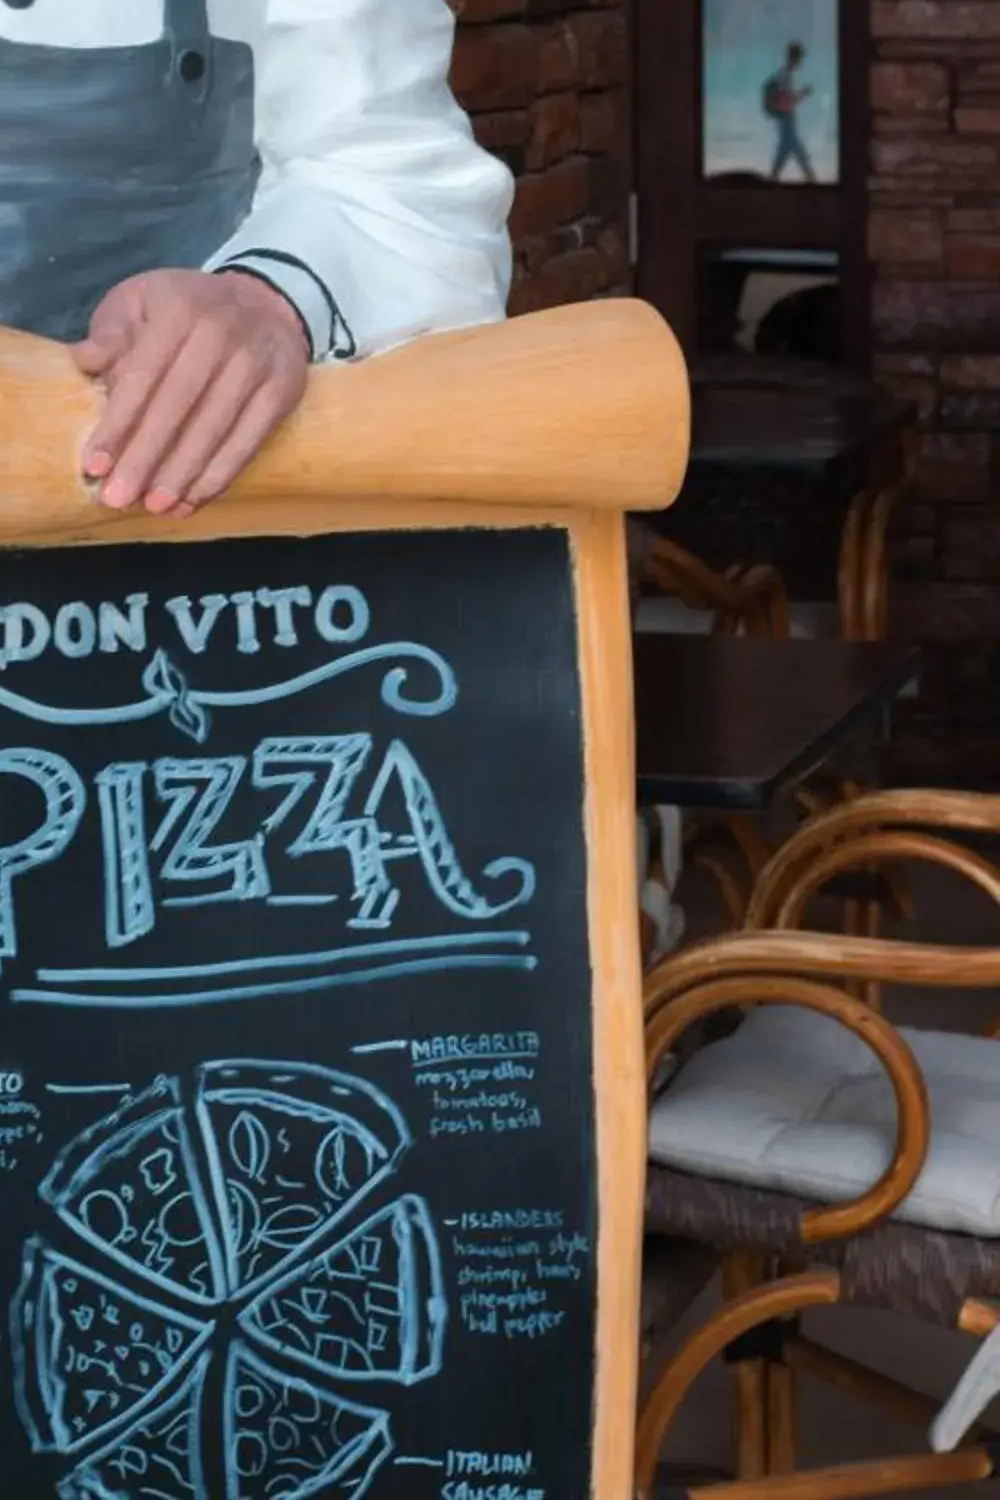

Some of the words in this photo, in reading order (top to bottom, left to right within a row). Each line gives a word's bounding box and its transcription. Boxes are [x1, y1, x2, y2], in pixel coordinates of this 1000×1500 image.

[165, 585, 370, 654] VITO
[411, 1031, 540, 1060] MARGARITA
[446, 1450, 532, 1477] ITALIAN
